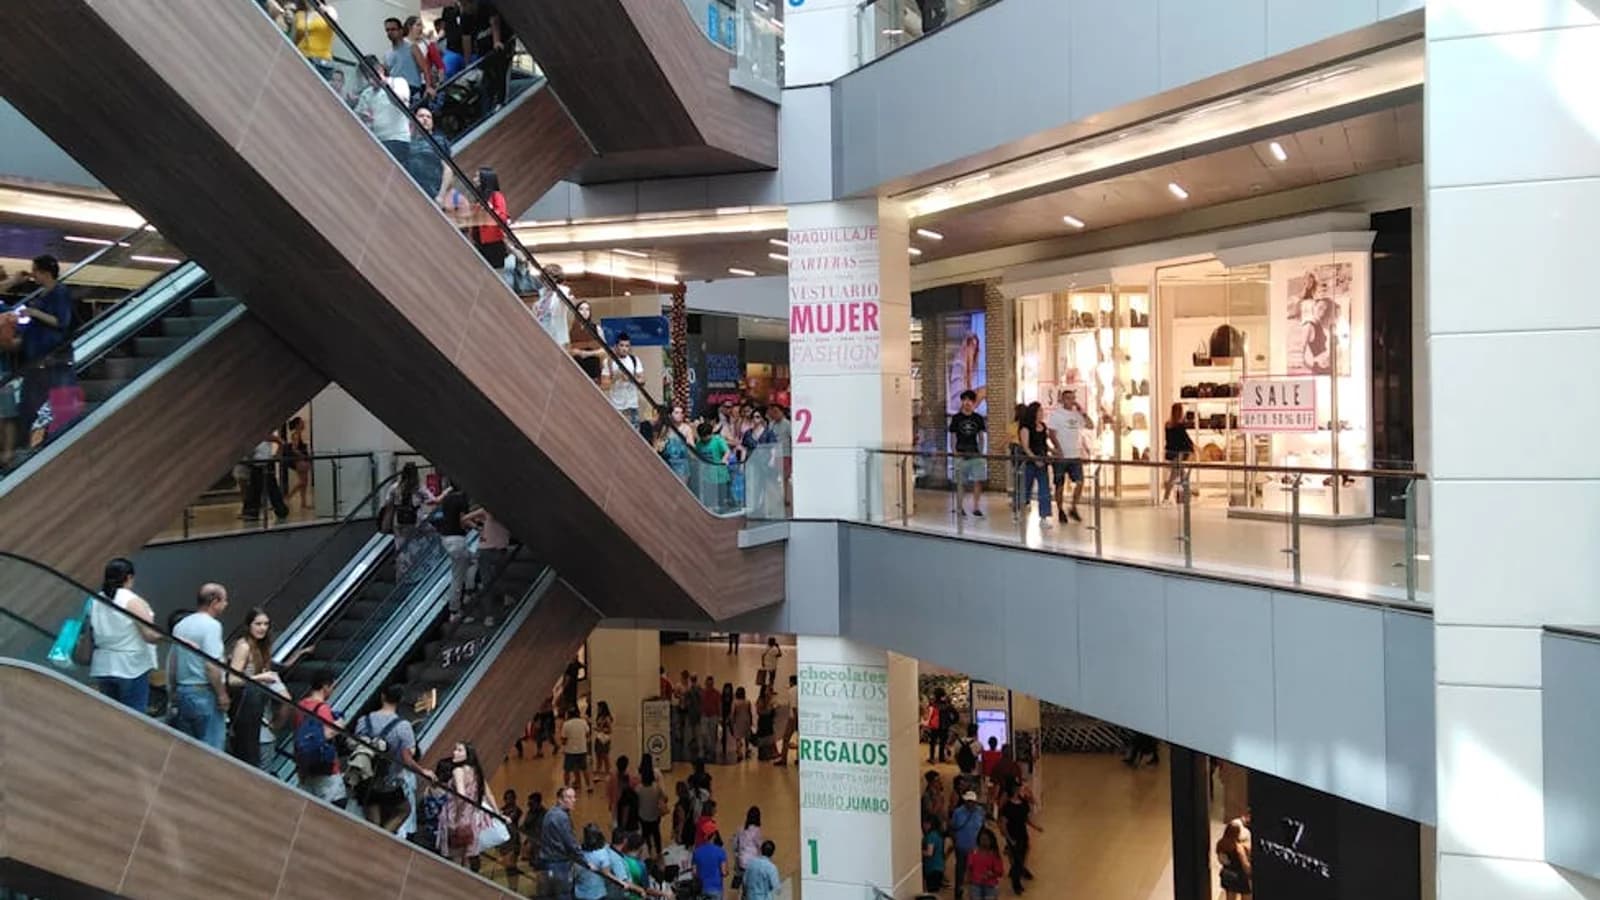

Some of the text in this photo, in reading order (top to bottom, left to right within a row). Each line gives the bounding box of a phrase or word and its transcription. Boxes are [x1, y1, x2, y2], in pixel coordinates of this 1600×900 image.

[789, 225, 879, 244] MAQUILLAJE
[791, 283, 879, 301] VESTUARIO
[790, 302, 879, 334] MUJER
[791, 343, 880, 363] FASHION
[1255, 383, 1301, 406] SALE
[794, 408, 812, 443] 2
[799, 665, 889, 684] chocolates
[800, 681, 888, 701] REGALOS
[800, 739, 889, 766] REGALOS
[846, 796, 890, 813] JUMBO
[807, 838, 819, 875] 1
